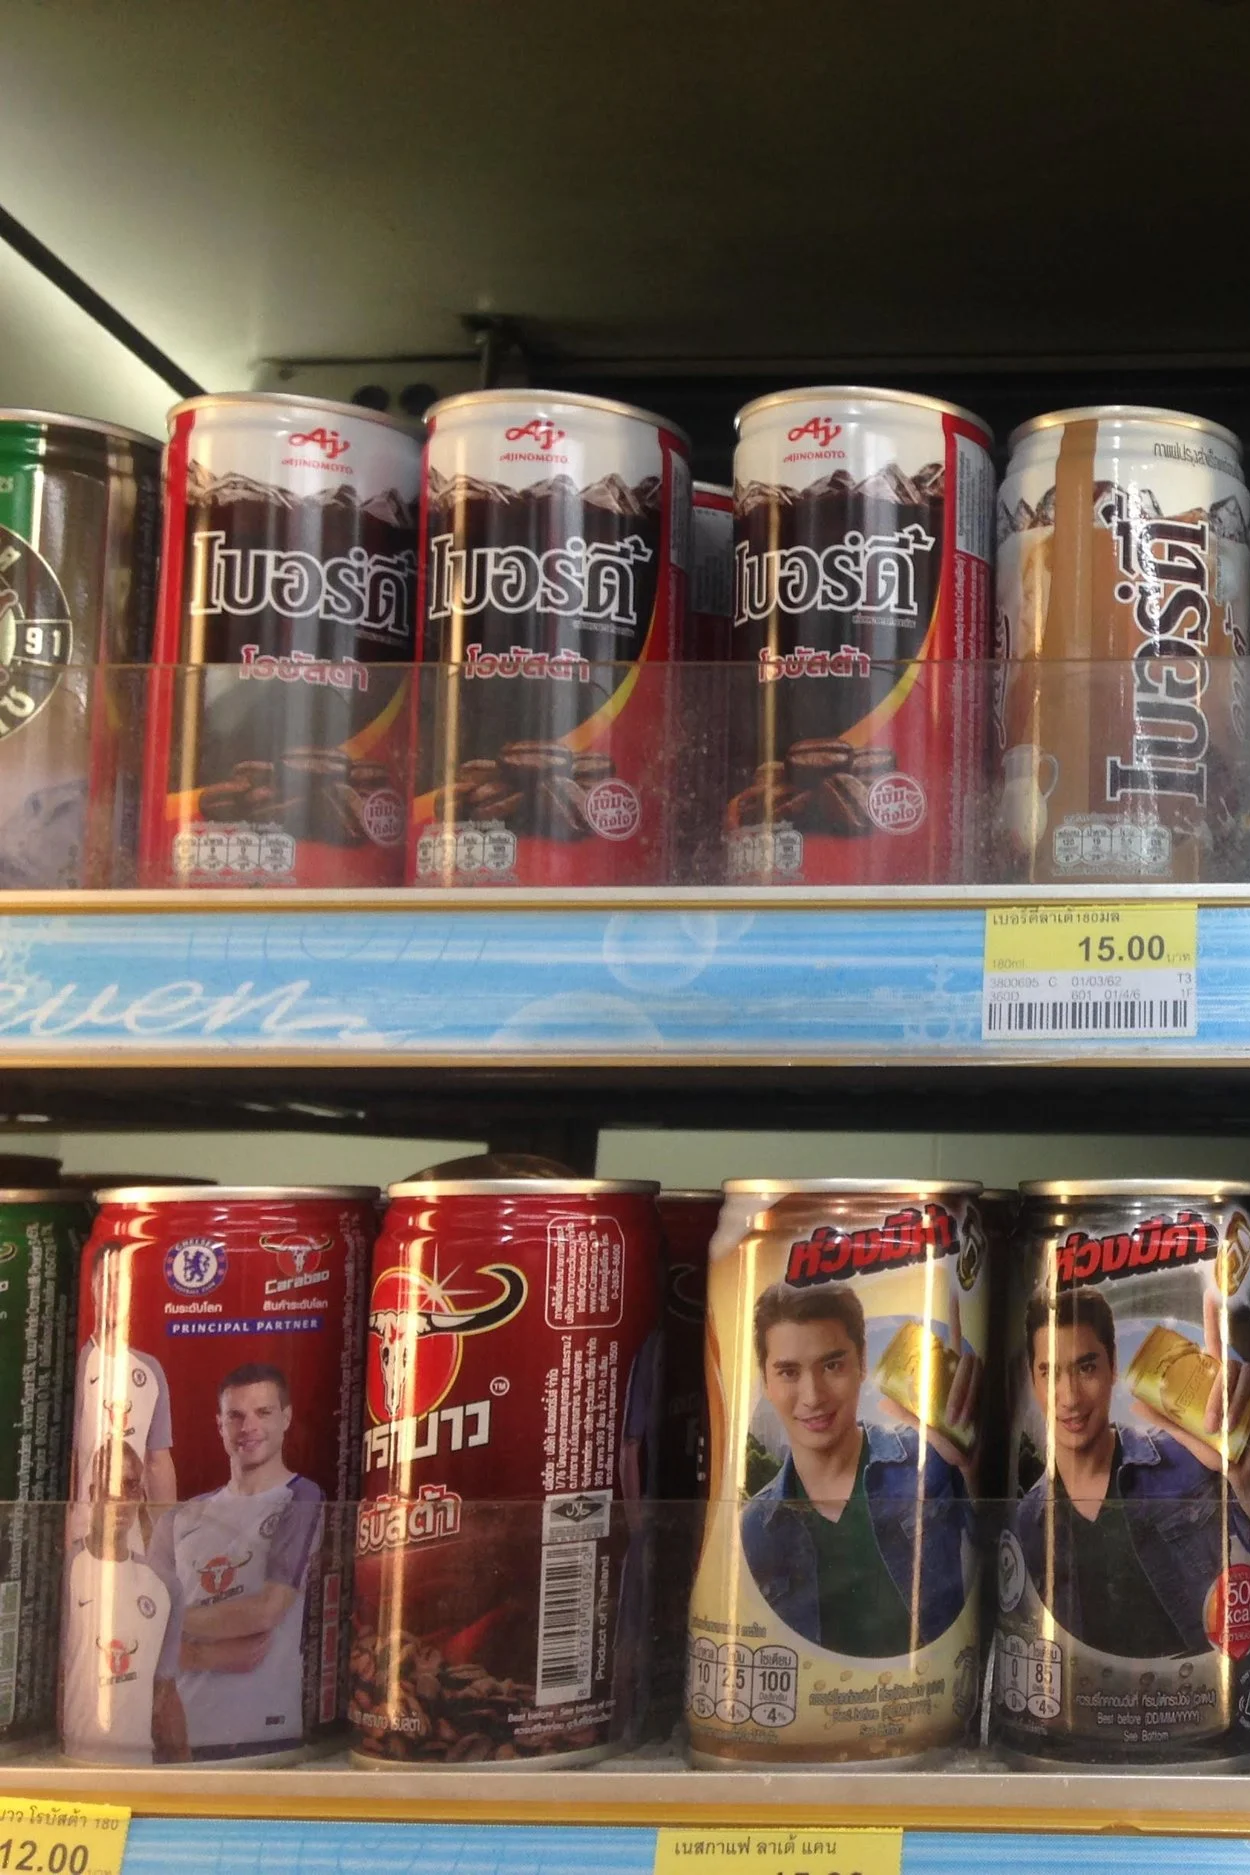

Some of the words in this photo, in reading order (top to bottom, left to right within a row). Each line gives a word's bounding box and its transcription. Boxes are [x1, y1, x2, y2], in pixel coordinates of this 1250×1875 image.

[281, 459, 353, 475] AJINOMOTO
[500, 452, 568, 463] AJINOMOTO
[784, 450, 846, 463] AJINOMOTO
[1078, 935, 1165, 962] 15.00
[1049, 977, 1057, 987] C
[1071, 976, 1122, 987] 01/03/62
[1177, 973, 1192, 984] T3
[1071, 990, 1092, 1001] 601
[265, 1270, 330, 1296] Carabao
[172, 1321, 250, 1334] PRINCIPAL
[256, 1319, 319, 1331] PARTNER
[598, 1556, 610, 1608] Thailand
[1227, 1581, 1250, 1607] 50
[595, 1629, 607, 1680] Product
[759, 1671, 791, 1692] 100
[1097, 1711, 1114, 1725] Best
[1117, 1711, 1141, 1726] before
[1123, 1729, 1138, 1743] See
[1142, 1729, 1169, 1743] Bottom
[30, 1805, 88, 1828] โรบัสต้า
[95, 1818, 119, 1831] 180
[674, 1837, 751, 1856] เนสกาแฟ
[756, 1834, 797, 1856] ลาเต้
[801, 1840, 838, 1856] แคน
[0, 1838, 89, 1875] 12.00
